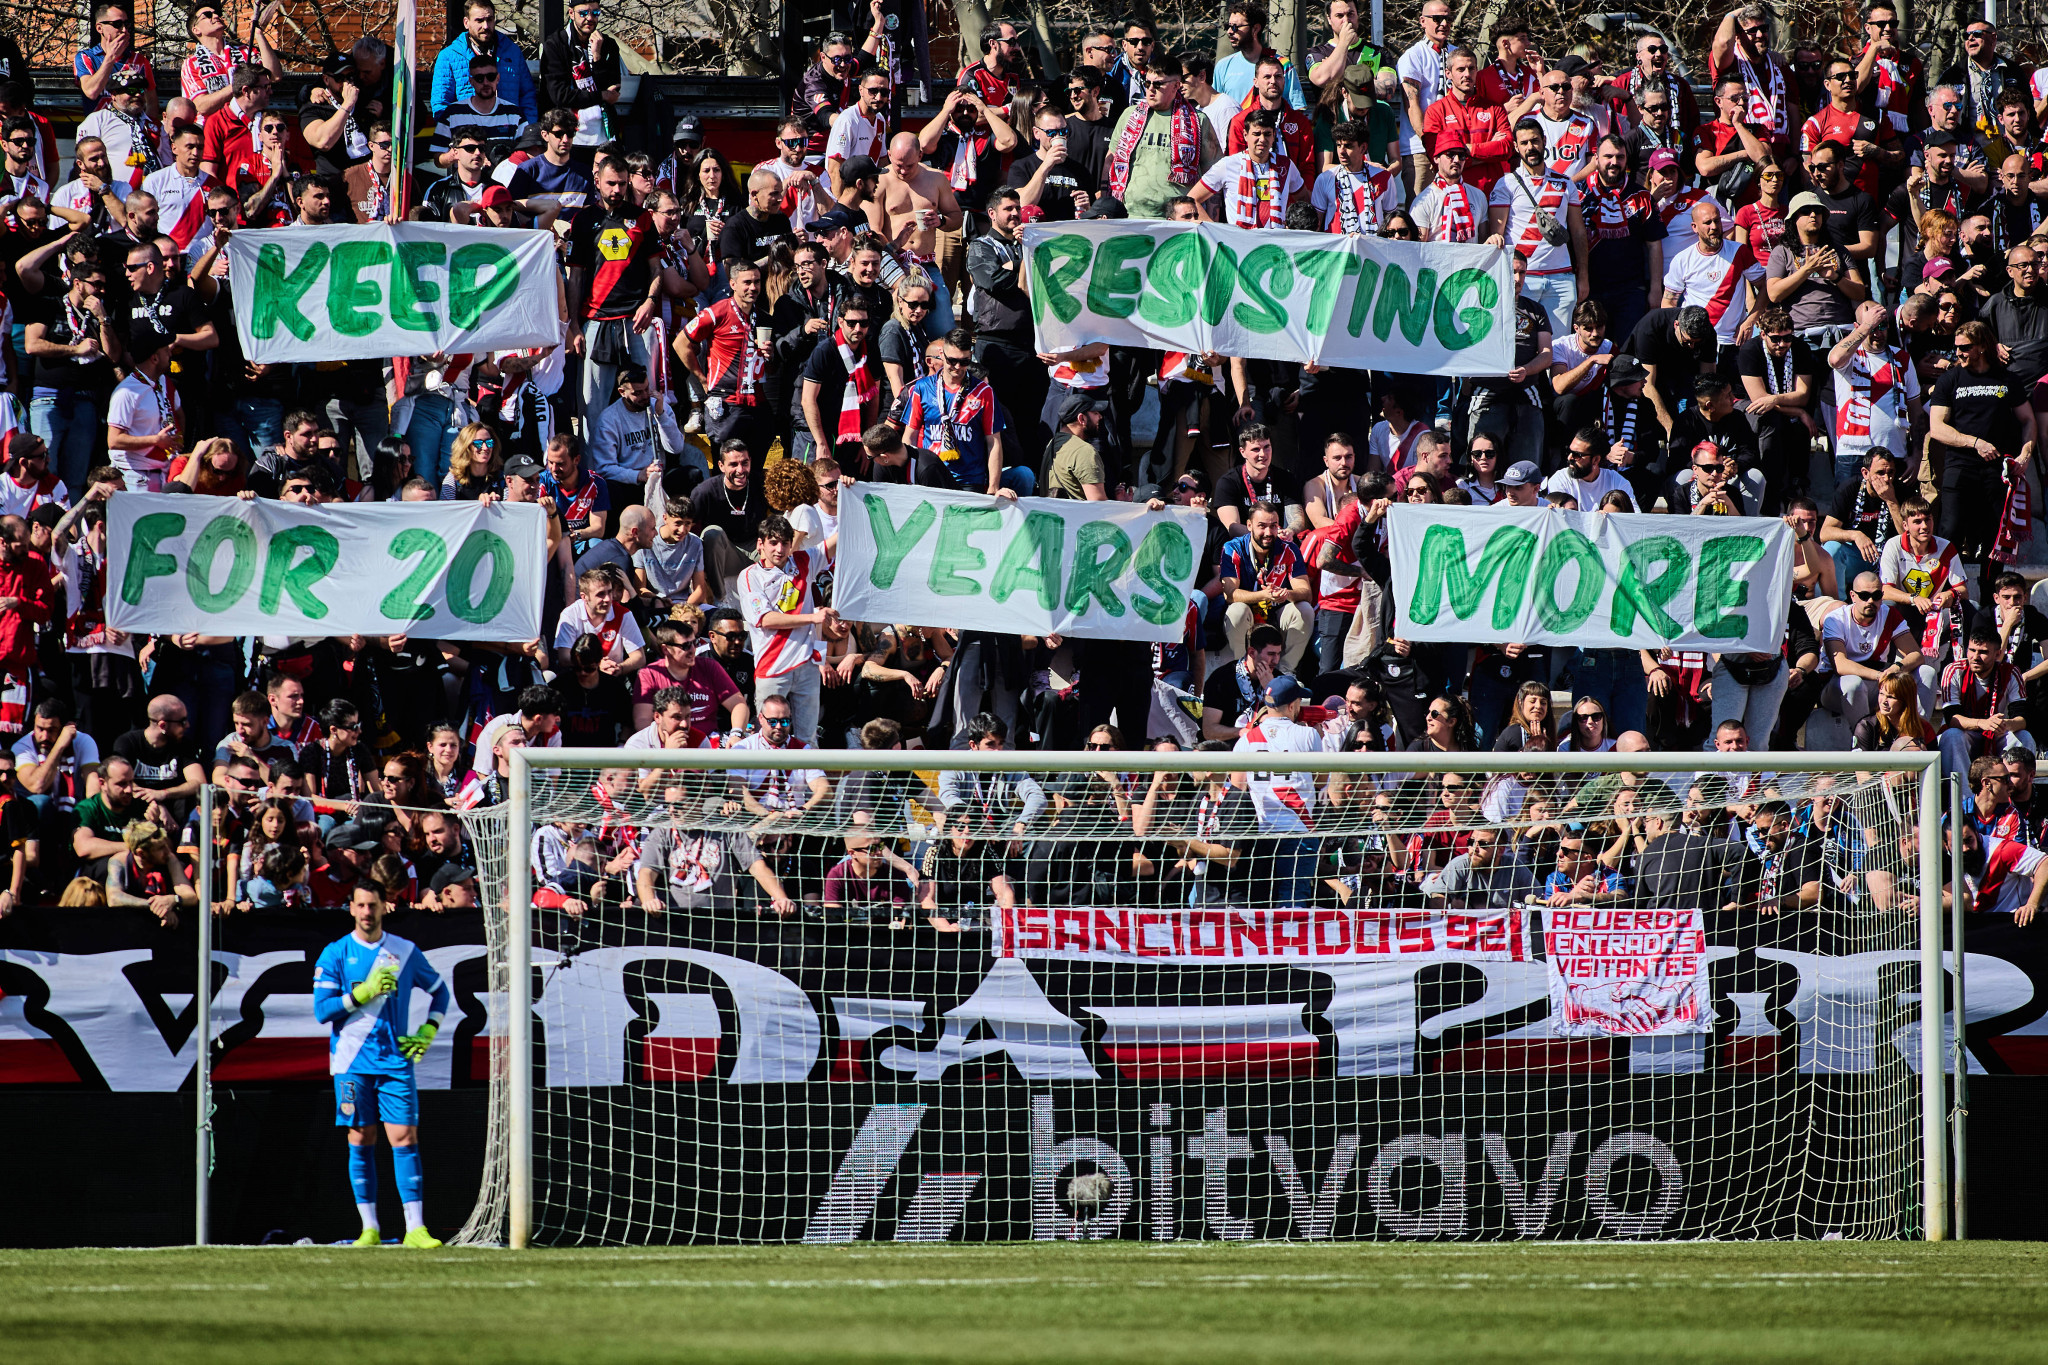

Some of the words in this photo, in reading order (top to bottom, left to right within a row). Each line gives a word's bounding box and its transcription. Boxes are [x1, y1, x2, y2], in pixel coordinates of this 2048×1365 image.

[1143, 132, 1171, 147] FLE
[251, 240, 520, 341] KEEP
[1032, 232, 1498, 350] RESISTING
[122, 512, 338, 620] FOR
[380, 528, 513, 623] 20
[865, 494, 1193, 625] YEARS
[1410, 523, 1765, 639] MORE
[1017, 909, 1436, 957] SANCIONADOS
[1551, 910, 1694, 931] ACUERDO
[1555, 932, 1697, 955] ENTRADAS
[1556, 956, 1698, 978] VISITANTES
[340, 1080, 356, 1102] 13
[1031, 1093, 1683, 1243] bitvavo
